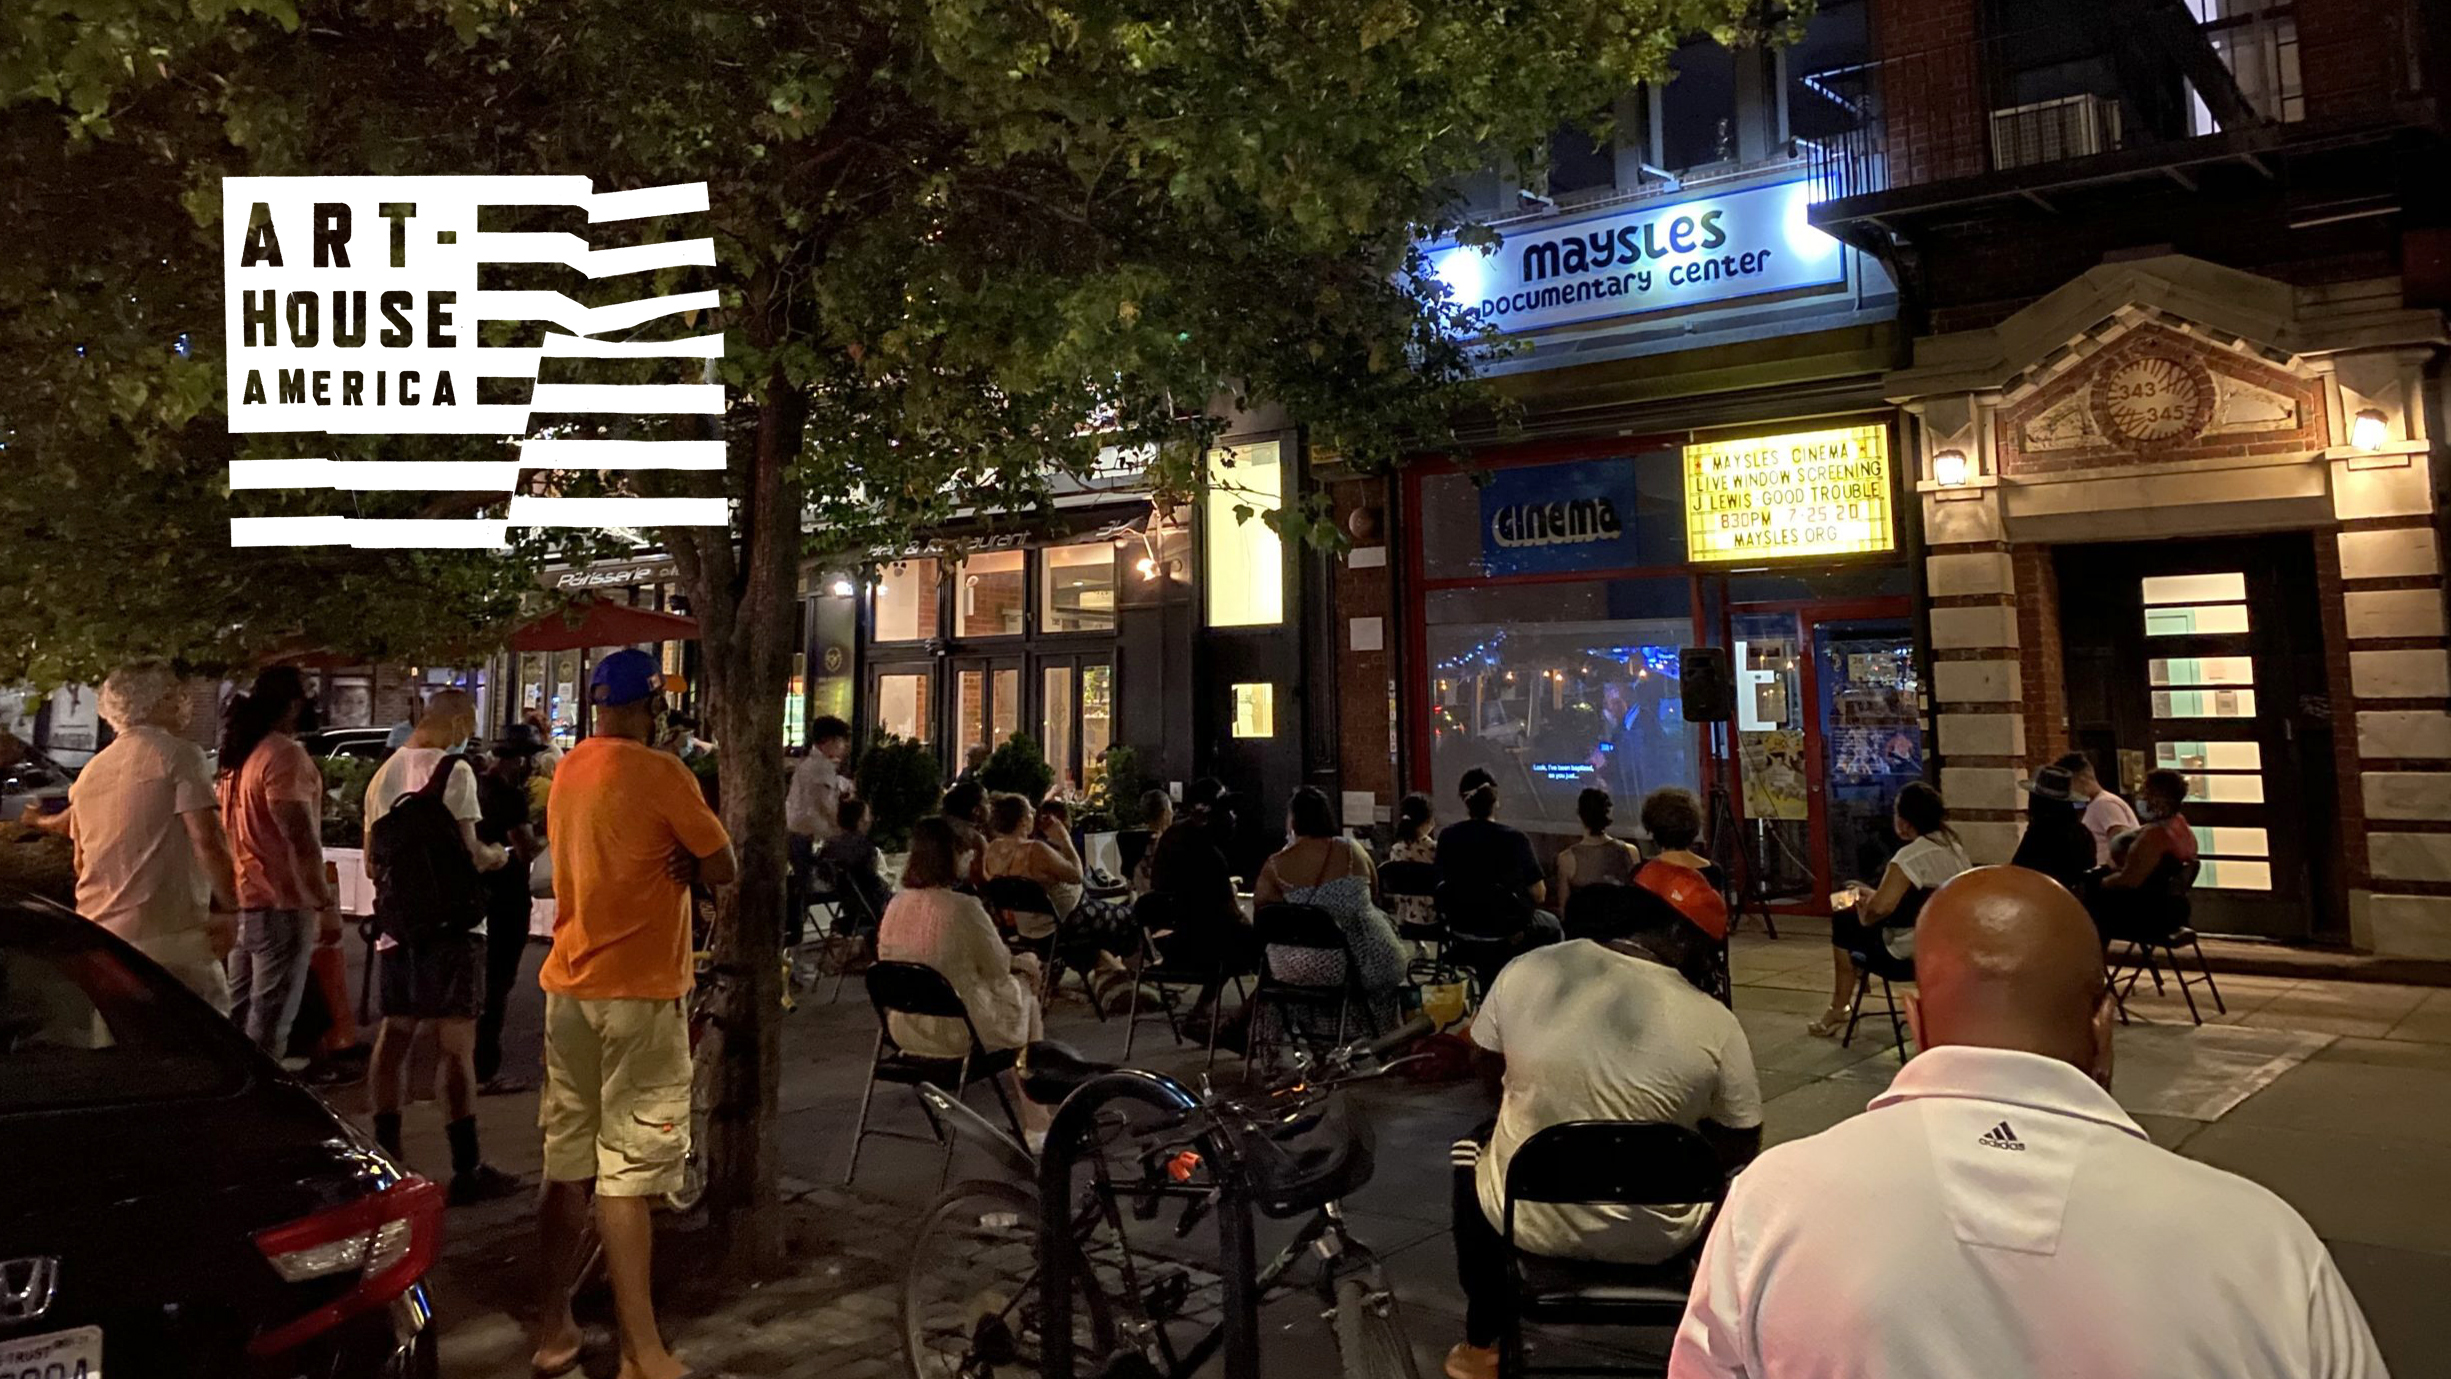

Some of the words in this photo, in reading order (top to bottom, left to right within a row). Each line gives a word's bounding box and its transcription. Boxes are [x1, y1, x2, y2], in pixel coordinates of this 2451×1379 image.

[1669, 248, 1772, 287] center
[2119, 382, 2156, 400] 343
[2146, 405, 2184, 423] 345
[1713, 450, 1779, 471] MAYSLES
[1792, 442, 1849, 464] CINEMA
[1696, 475, 1728, 492] LIVE
[1733, 470, 1790, 488] WINDOW
[1797, 461, 1882, 482] SCREENING
[1693, 497, 1702, 511] J
[1711, 493, 1752, 510] LEWIS
[1811, 481, 1880, 502] TROUBLE
[1492, 497, 1622, 548] cinema
[1721, 511, 1772, 529] 830PM
[1734, 528, 1799, 547] MAYSLES
[1805, 525, 1837, 543] ORG
[1978, 1137, 2026, 1152] adidas
